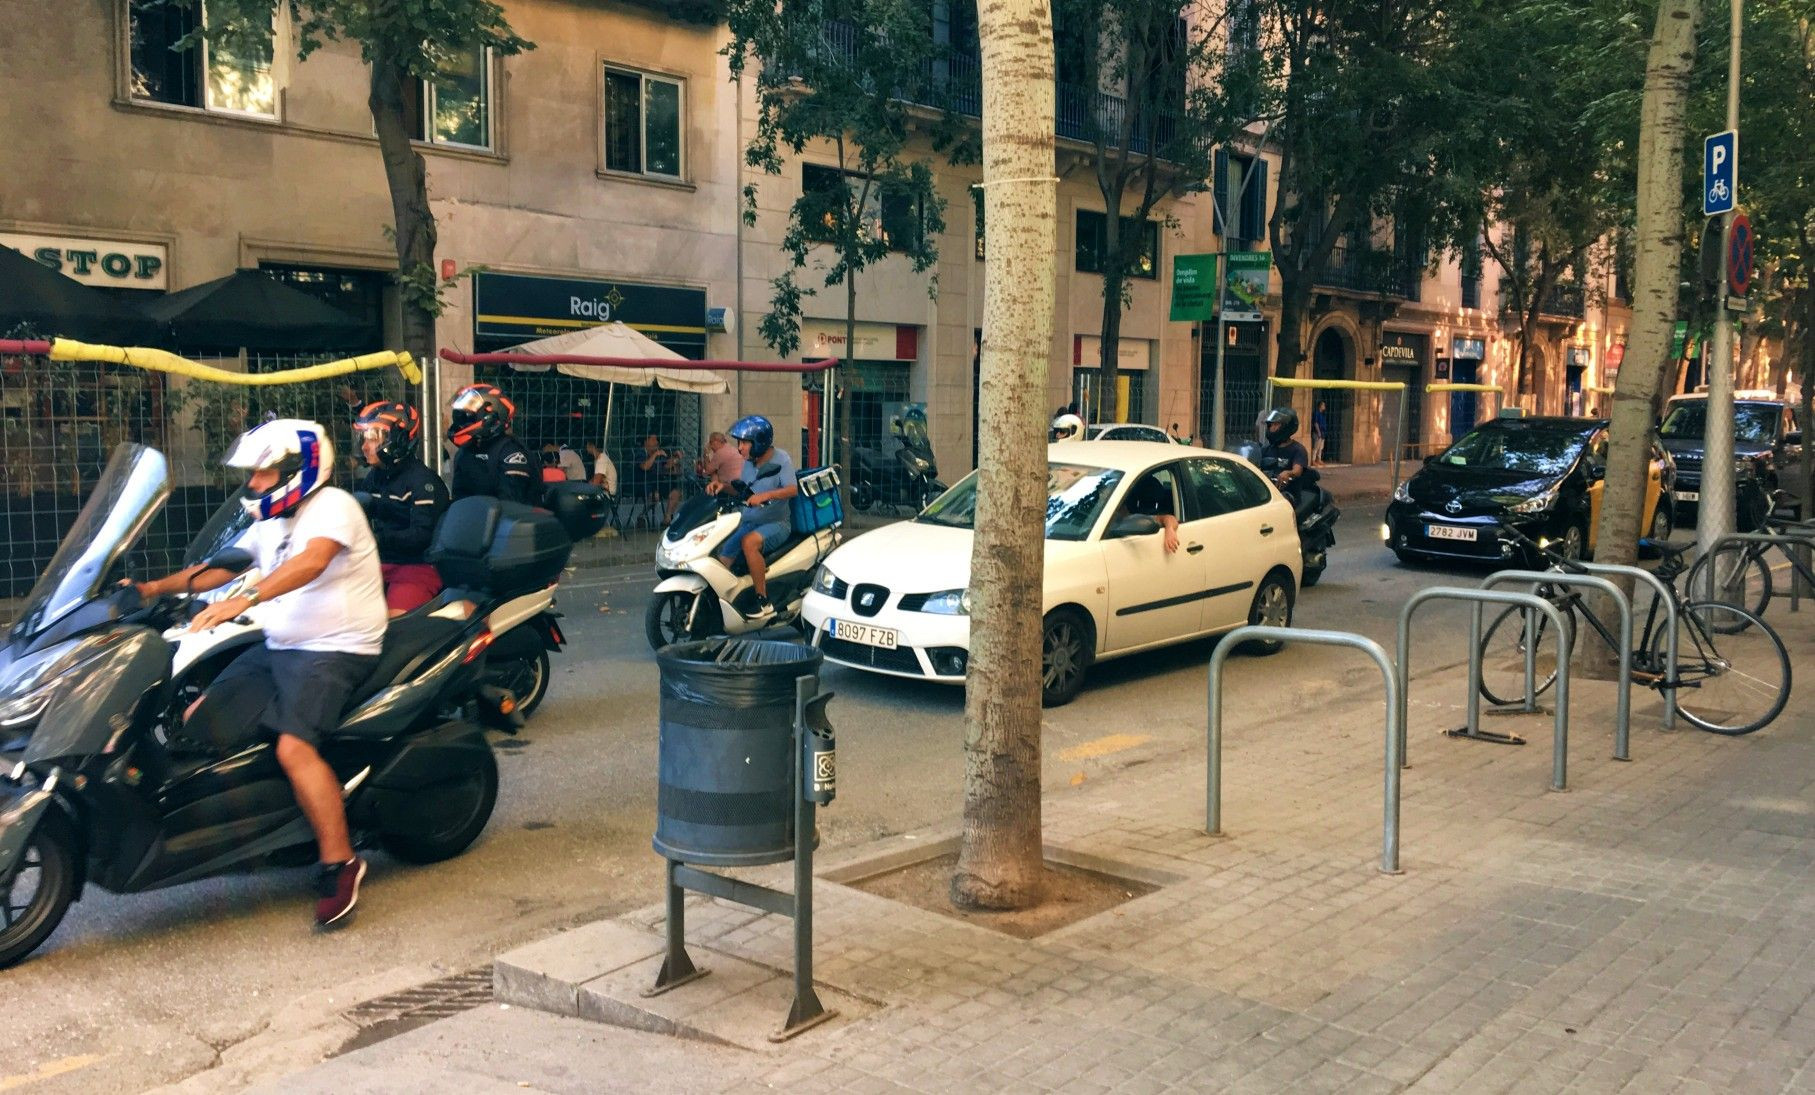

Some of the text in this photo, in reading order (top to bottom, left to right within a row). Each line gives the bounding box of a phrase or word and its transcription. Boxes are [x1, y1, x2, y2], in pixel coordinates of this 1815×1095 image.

[1712, 145, 1727, 175] P
[570, 296, 610, 321] Raig
[1382, 346, 1415, 359] CAPDEVILA
[1430, 527, 1475, 539] 2782 JVM
[837, 622, 895, 647] 8097 FZB
